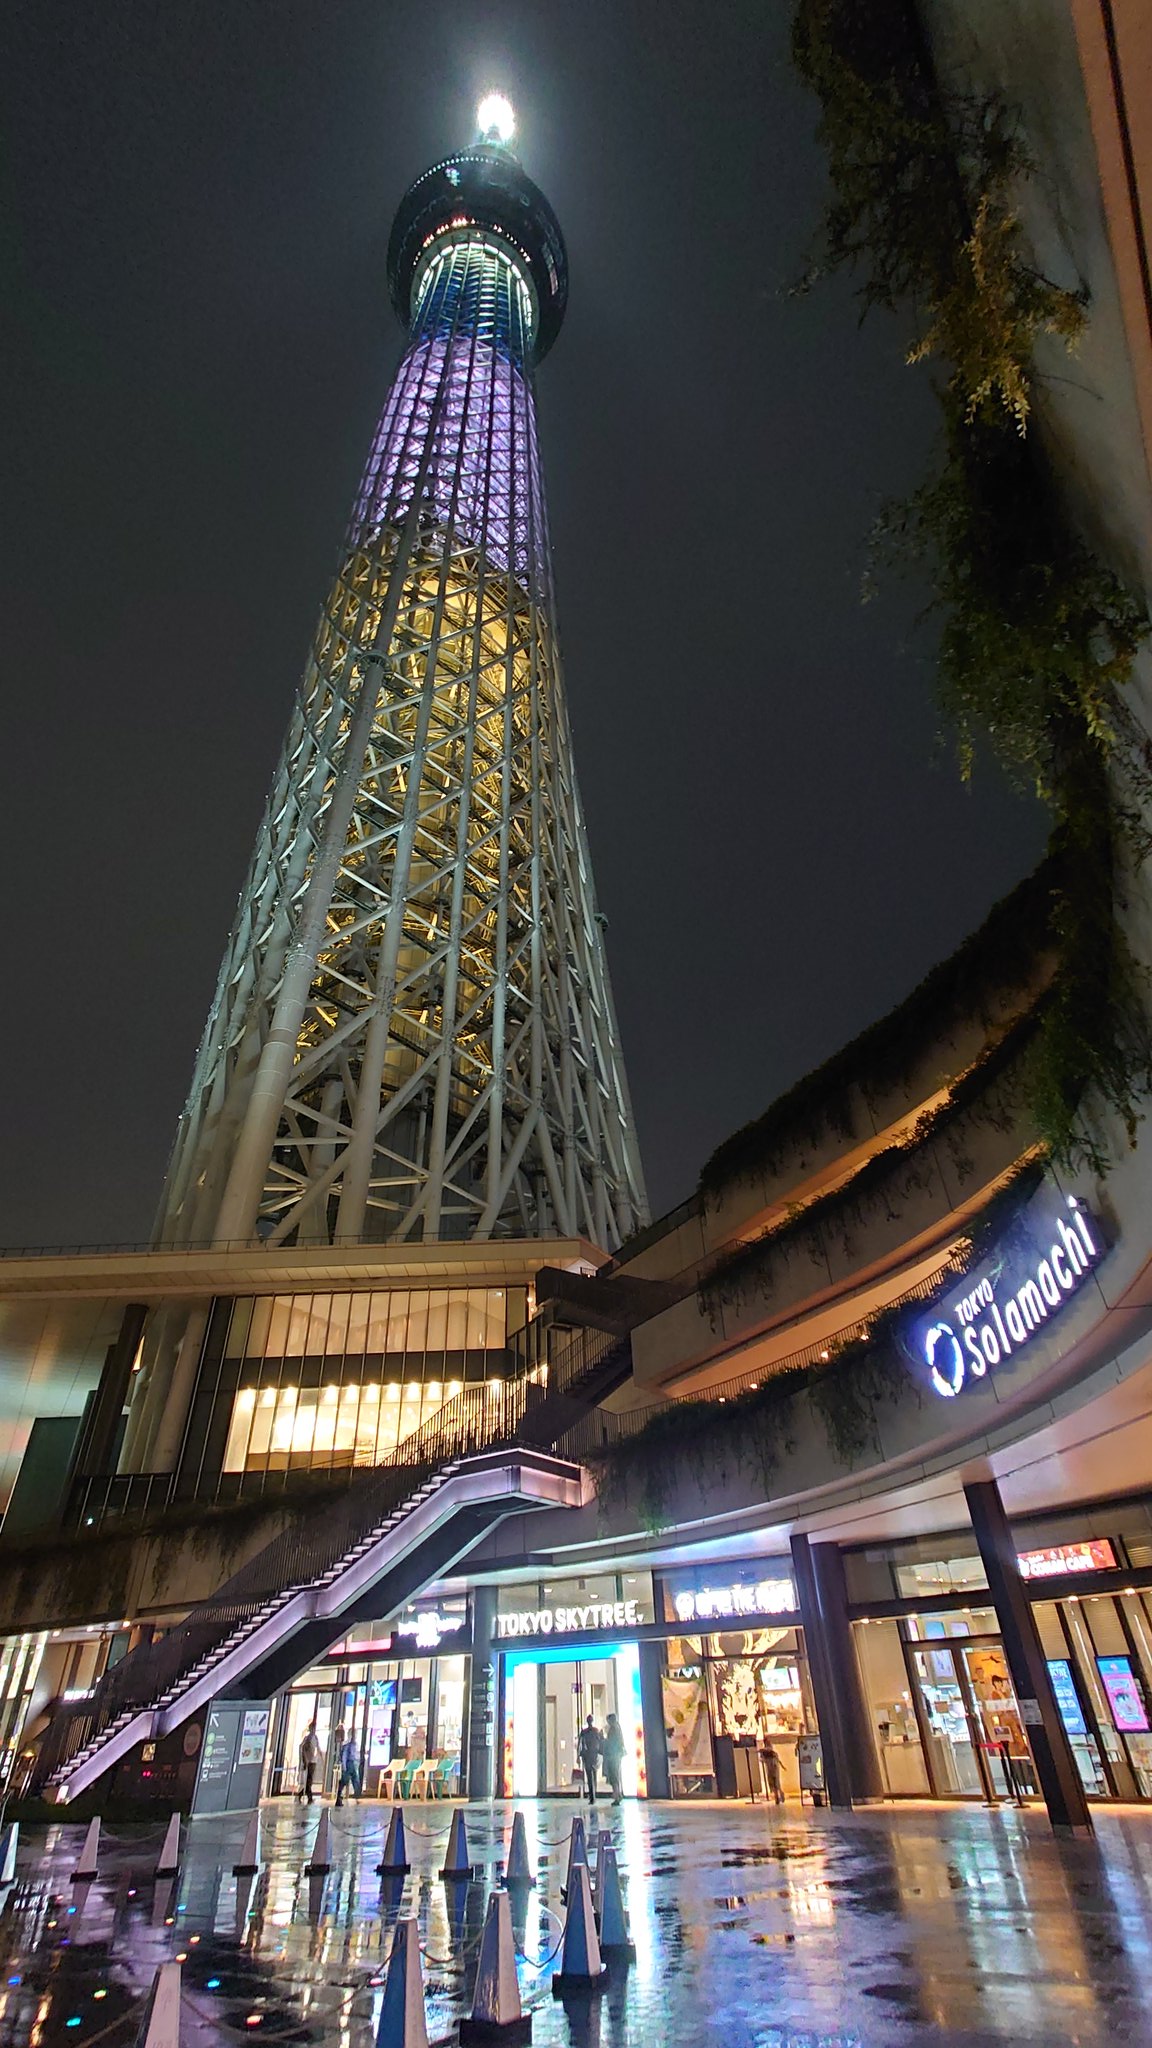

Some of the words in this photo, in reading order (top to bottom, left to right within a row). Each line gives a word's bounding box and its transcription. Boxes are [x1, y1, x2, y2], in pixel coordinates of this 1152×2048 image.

[955, 1277, 994, 1326] TOKYO
[964, 1195, 1096, 1377] Solamachi
[497, 1609, 553, 1638] TOKYO
